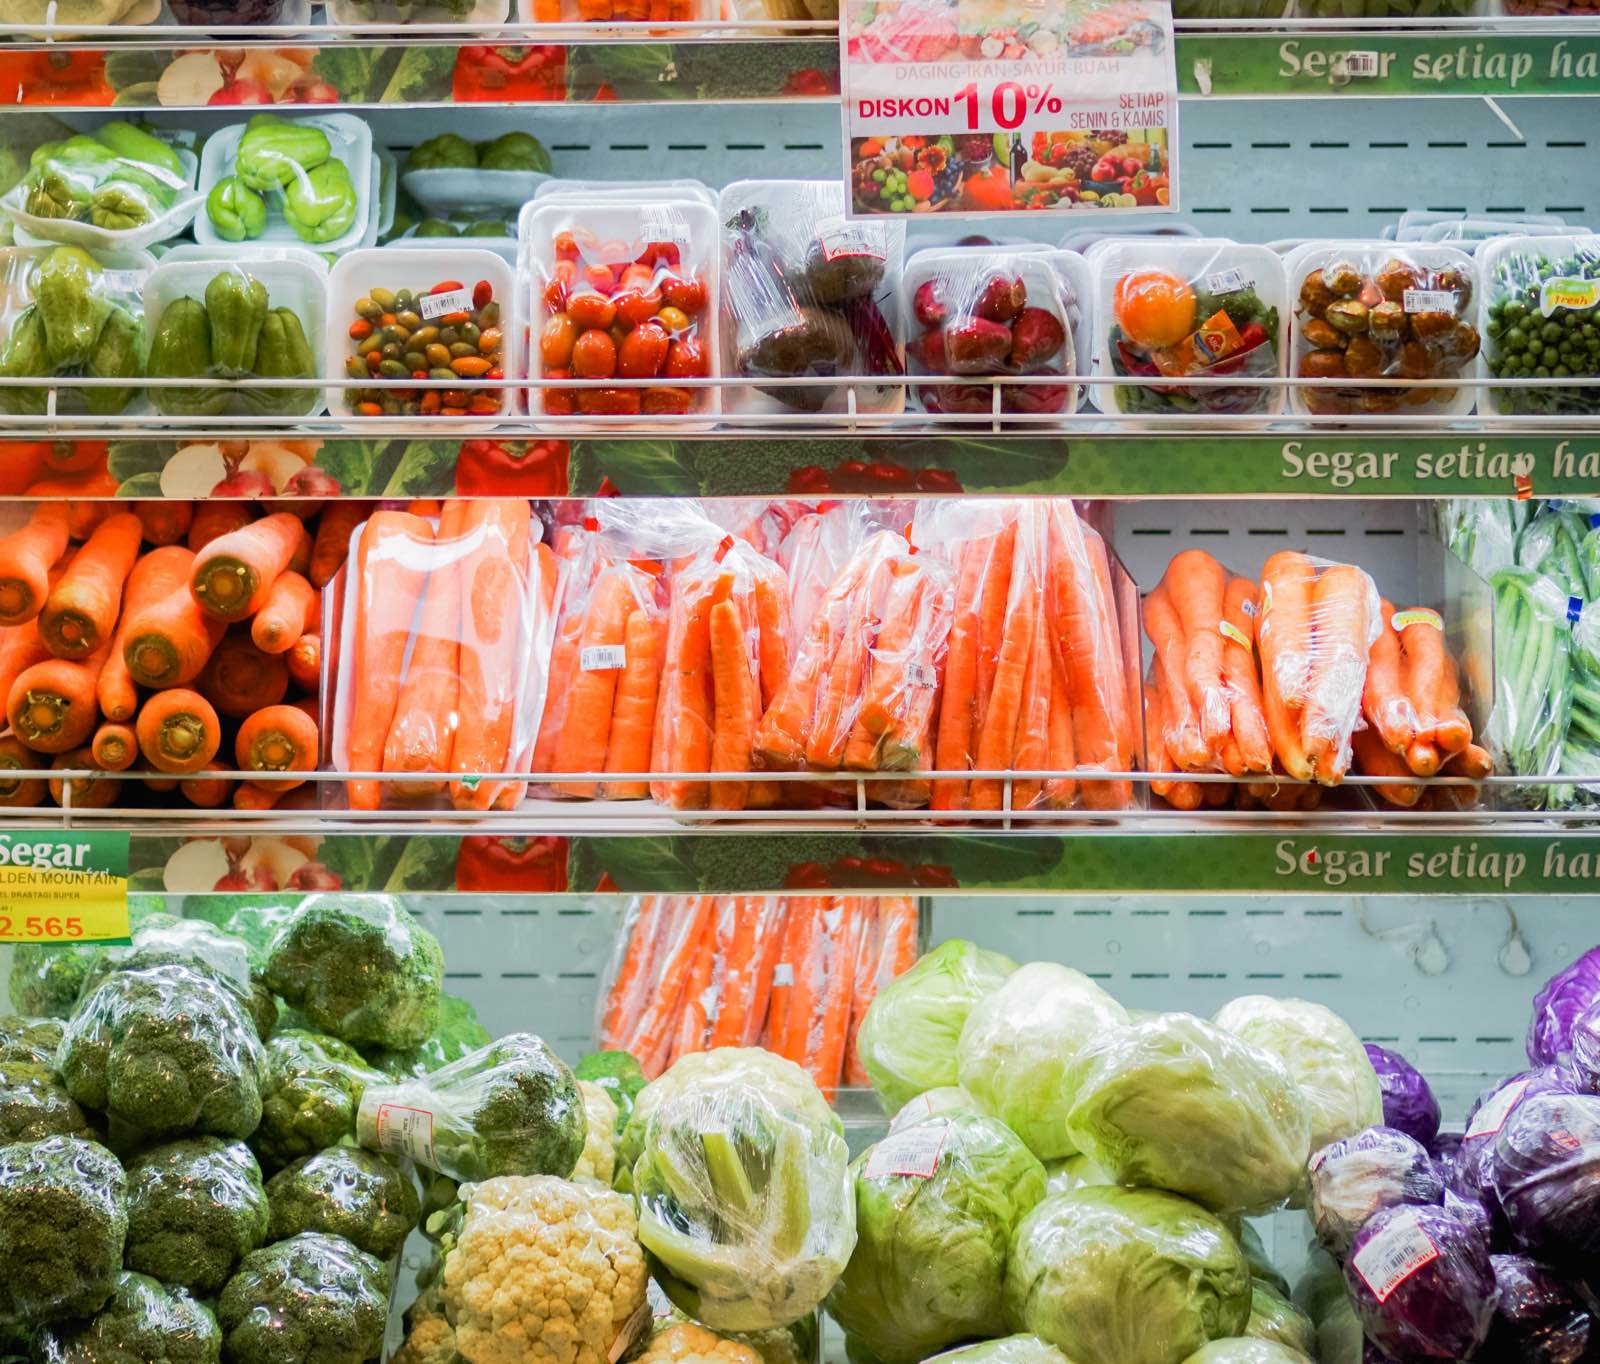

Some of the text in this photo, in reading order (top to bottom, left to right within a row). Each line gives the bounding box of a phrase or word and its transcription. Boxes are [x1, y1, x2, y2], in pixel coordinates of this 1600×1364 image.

[1279, 41, 1396, 86] Segr
[1412, 42, 1534, 88] setiap
[859, 81, 1062, 130] DISKON 10%
[1070, 110, 1164, 129] SENIN & KAMIS
[1119, 92, 1164, 109] SETIAP
[1281, 441, 1399, 487] Segar
[0, 835, 91, 874] Segar
[1275, 840, 1391, 885] Segar
[1407, 842, 1527, 887] setiap
[41, 872, 118, 885] MOUNTAIN
[0, 915, 84, 937] 2.565
